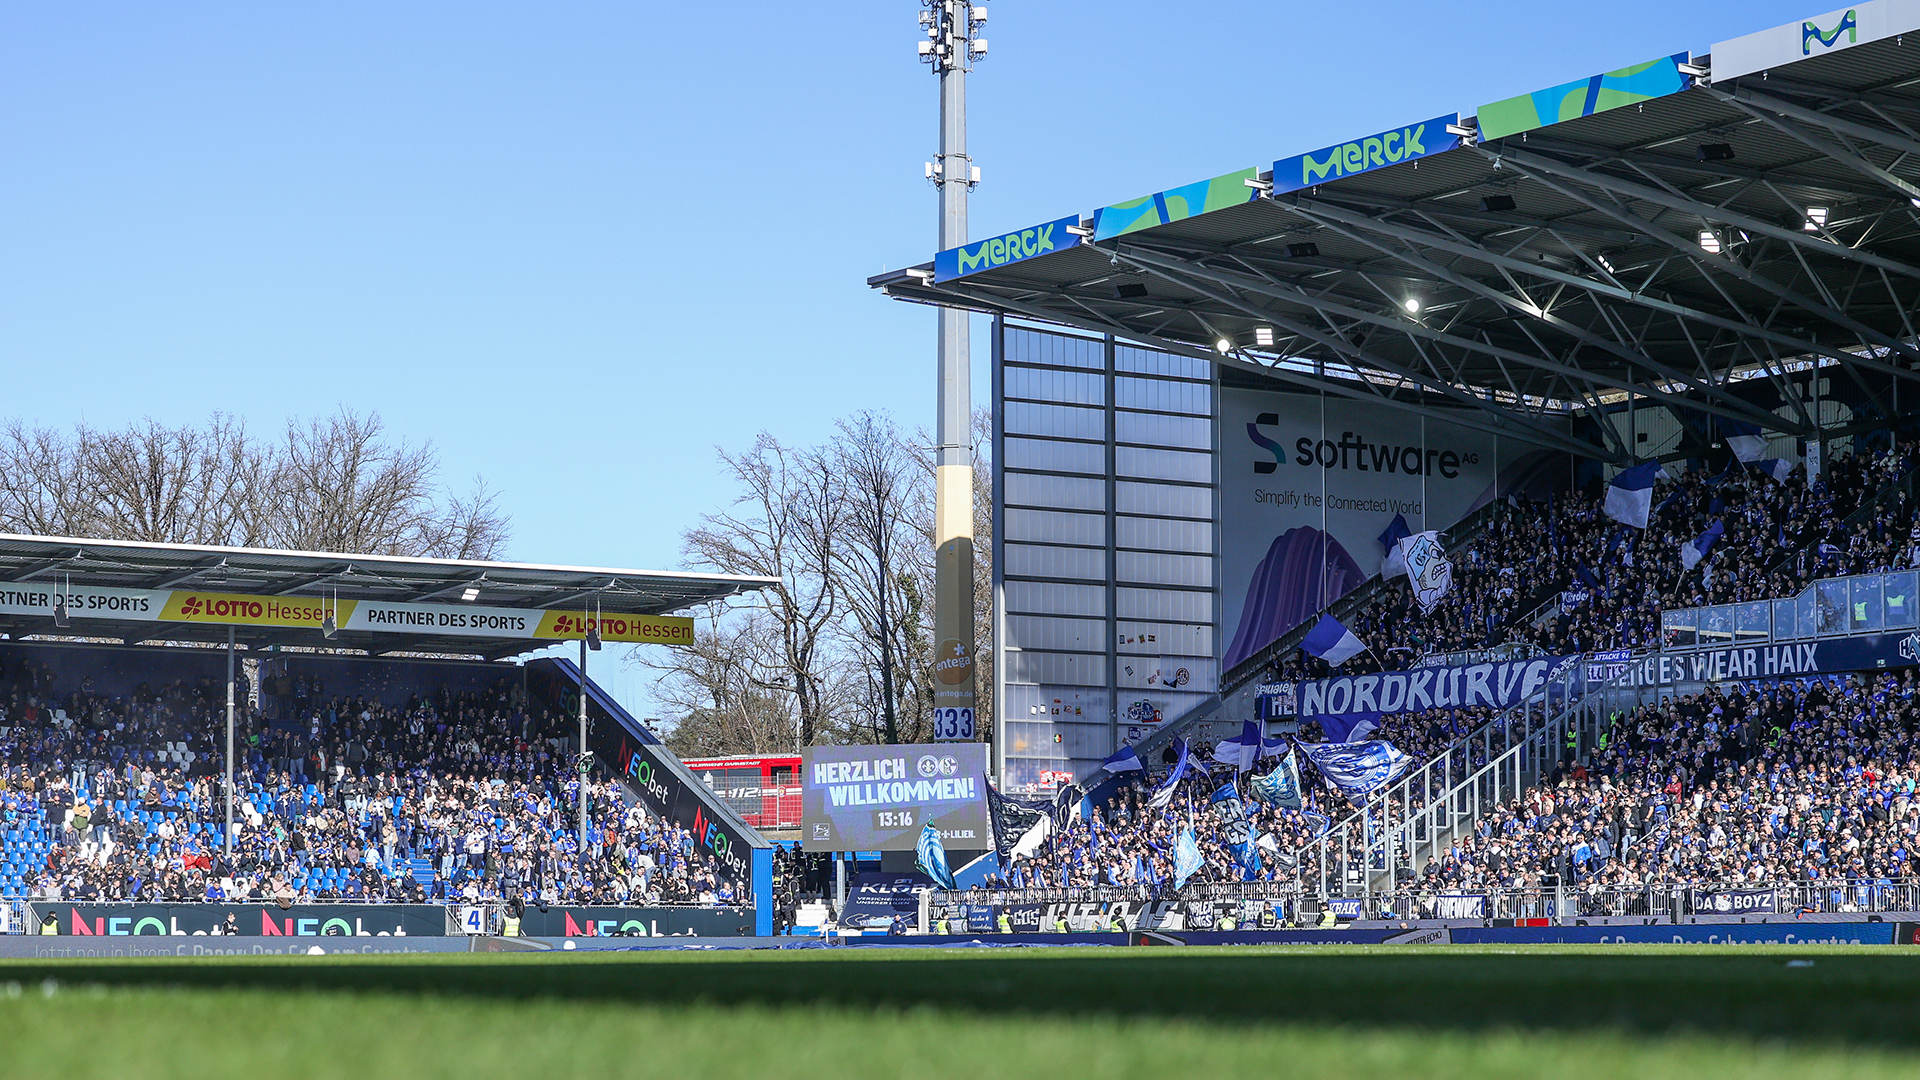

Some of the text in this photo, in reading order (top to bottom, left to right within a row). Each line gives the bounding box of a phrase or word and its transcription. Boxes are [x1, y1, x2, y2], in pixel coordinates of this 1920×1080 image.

[1295, 431, 1479, 479] software AG
[1255, 489, 1422, 515] Simplify the Connected World
[88, 596, 149, 612] SPORTS
[206, 599, 334, 621] LOTTO Hessen
[368, 609, 525, 630] PARTNER DES SPORTS
[631, 621, 691, 639] Hessen
[936, 656, 971, 671] entega
[1690, 649, 1757, 682] WEAR
[1764, 643, 1819, 675] HAIX
[1303, 659, 1549, 717] NORDKURVE
[935, 708, 972, 738] 333
[814, 758, 906, 784] HERZLICH
[829, 777, 976, 807] WILLKOMMEN!
[878, 812, 913, 827] 13:16
[1547, 900, 1555, 916] 6
[1696, 893, 1771, 910] DA BOYZ
[467, 910, 481, 930] 4
